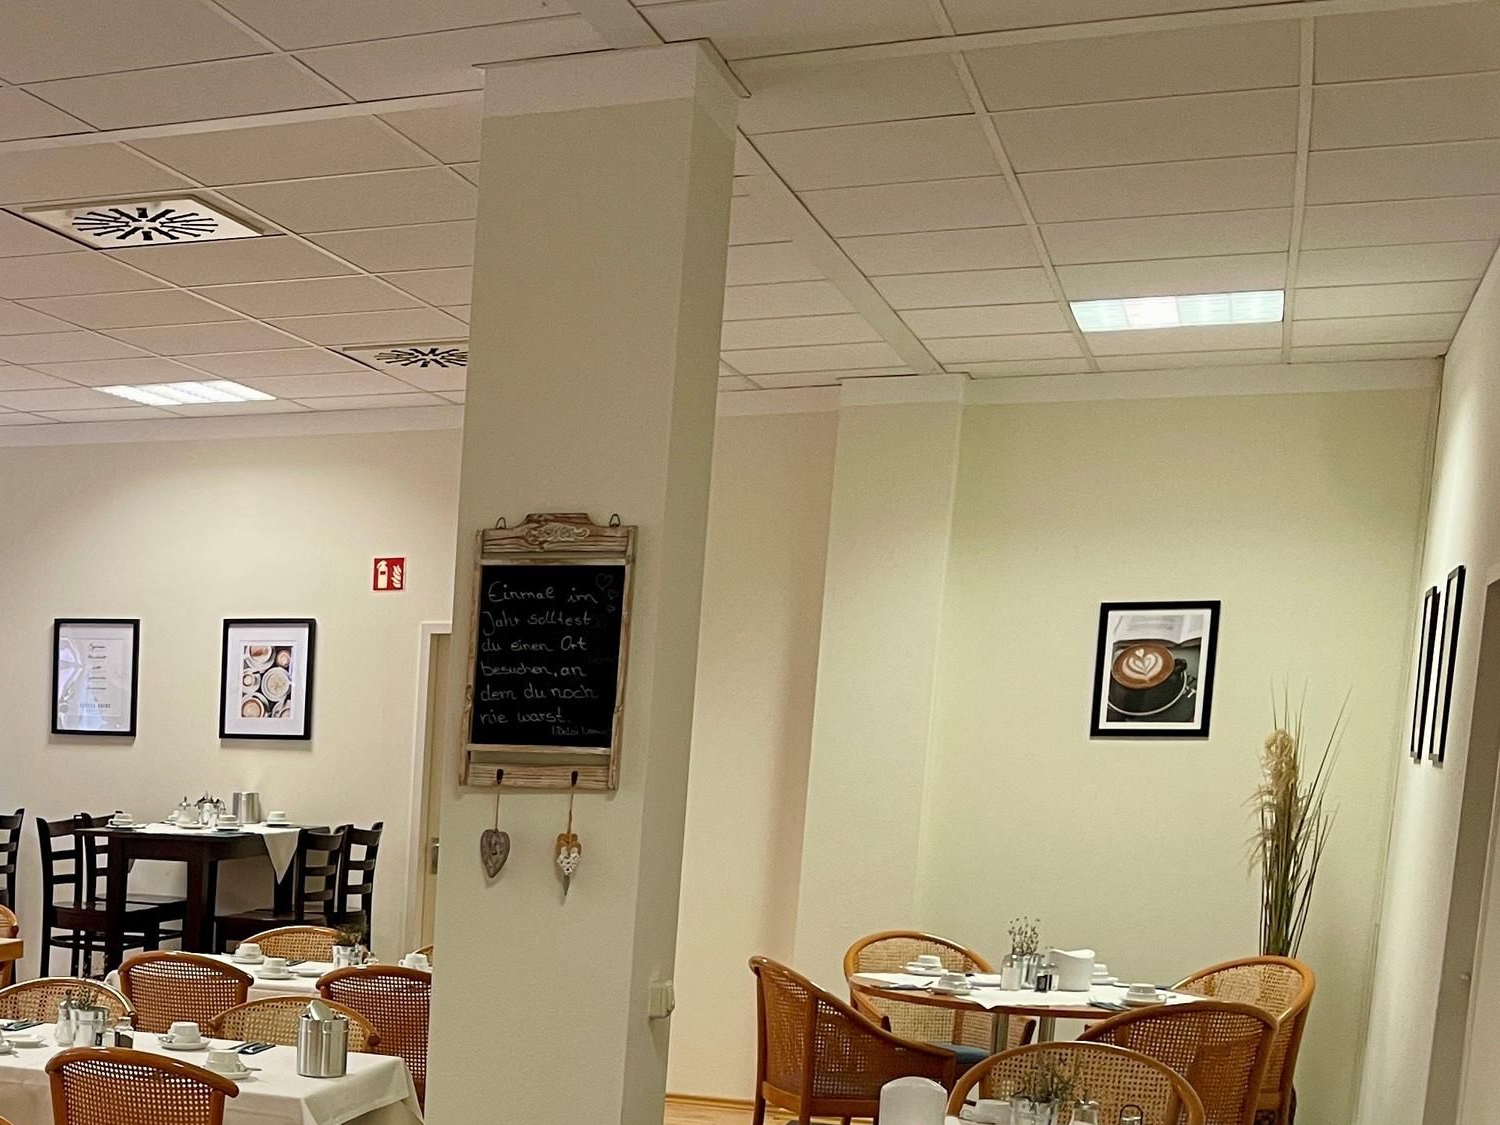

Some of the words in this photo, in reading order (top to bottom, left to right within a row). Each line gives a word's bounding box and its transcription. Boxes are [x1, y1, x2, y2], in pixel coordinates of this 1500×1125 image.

[489, 581, 555, 602] Einmal
[567, 587, 598, 604] im
[482, 610, 520, 636] Jahr
[527, 611, 592, 626] solltest
[481, 636, 502, 652] du
[511, 639, 554, 652] einen
[560, 635, 588, 651] Ort
[560, 666, 587, 677] an
[480, 683, 518, 701] dem
[524, 682, 547, 699] du
[551, 685, 599, 699] noch
[479, 709, 509, 725] nie
